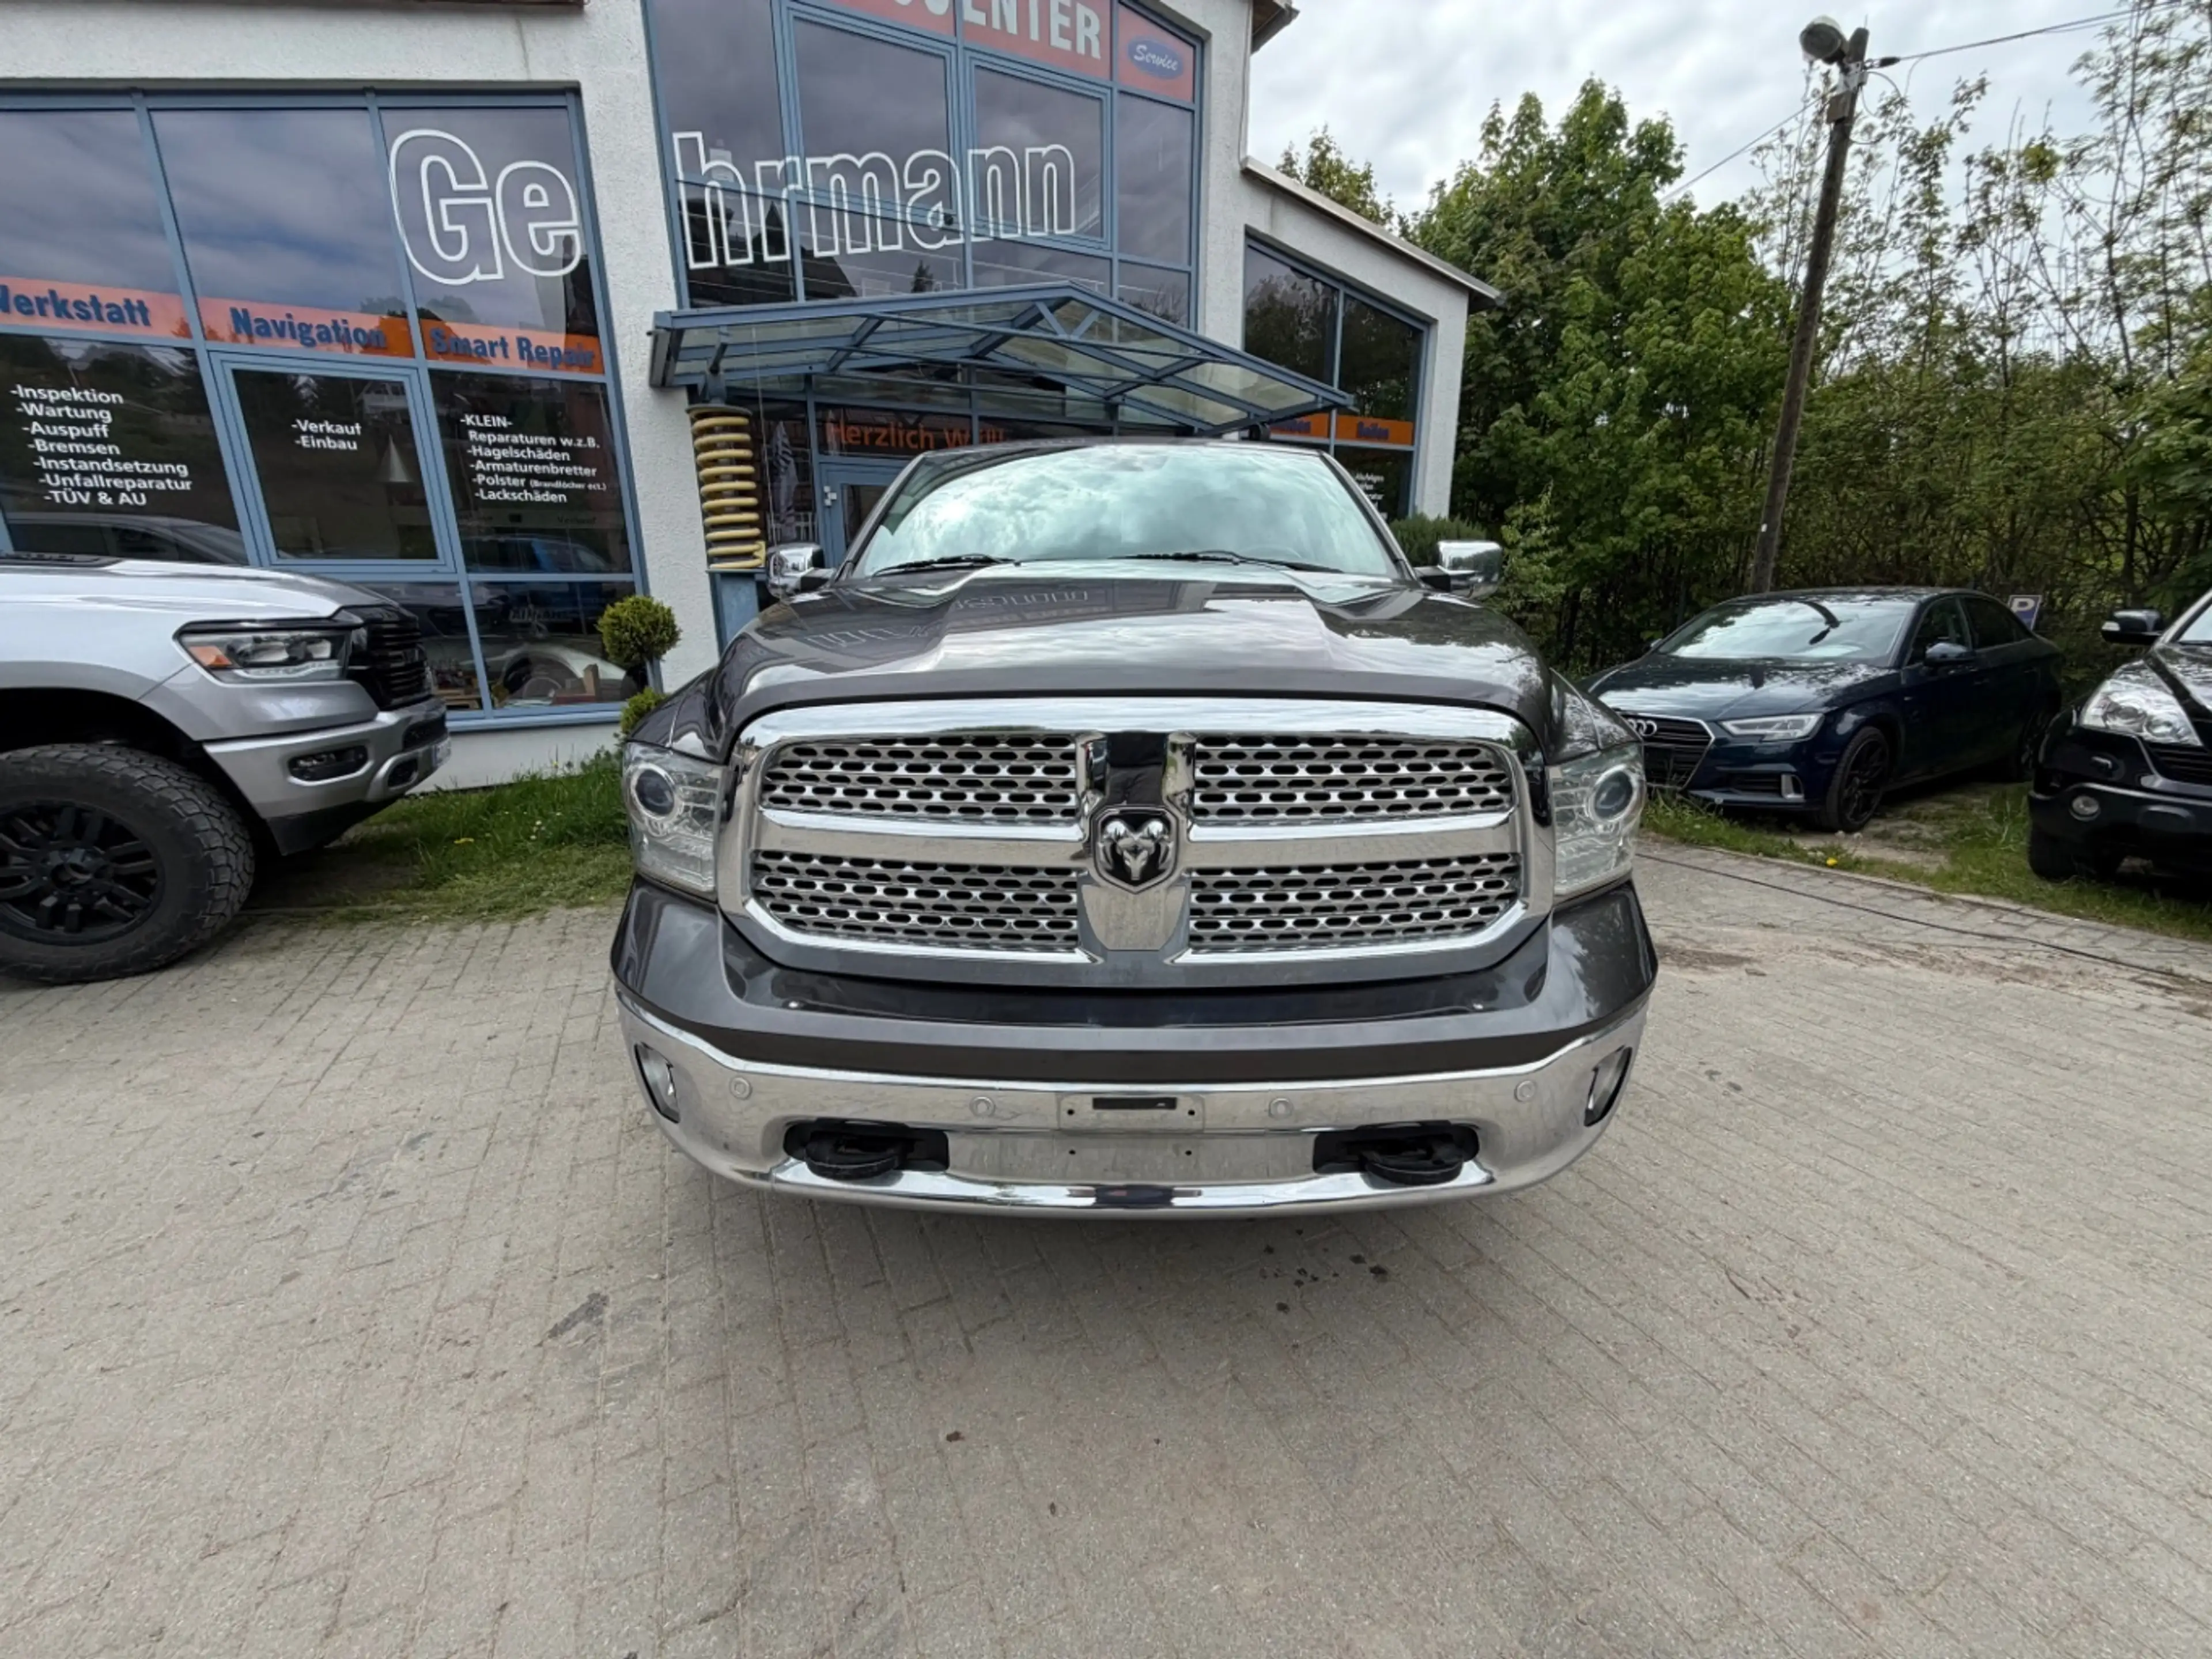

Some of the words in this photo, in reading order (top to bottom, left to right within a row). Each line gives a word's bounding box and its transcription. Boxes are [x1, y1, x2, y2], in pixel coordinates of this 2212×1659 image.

[1133, 44, 1179, 71] Service
[229, 306, 387, 349] Navigation
[430, 327, 509, 359] Smart
[515, 336, 595, 369] Repair
[10, 384, 124, 404] -Inspektion
[16, 402, 113, 423] -Wartung
[460, 413, 513, 428] -KLEIN-
[21, 421, 109, 440] -Auspuff
[468, 430, 557, 446] Reparaturen
[826, 419, 935, 450] Herzlich
[28, 438, 121, 455] -Bremsen
[294, 434, 358, 451] -Einbau
[467, 445, 571, 461] -Hagelschäden
[33, 455, 189, 478] -Instandsetzung
[470, 460, 598, 477] -Armaturenbretter
[39, 473, 192, 491] -Unfallreparatur
[472, 474, 526, 487] -Polster
[44, 488, 90, 504] -TÜV
[97, 491, 113, 505] &
[118, 492, 146, 506] AU
[475, 488, 568, 503] -Lackschäden
[2011, 597, 2035, 613] P
